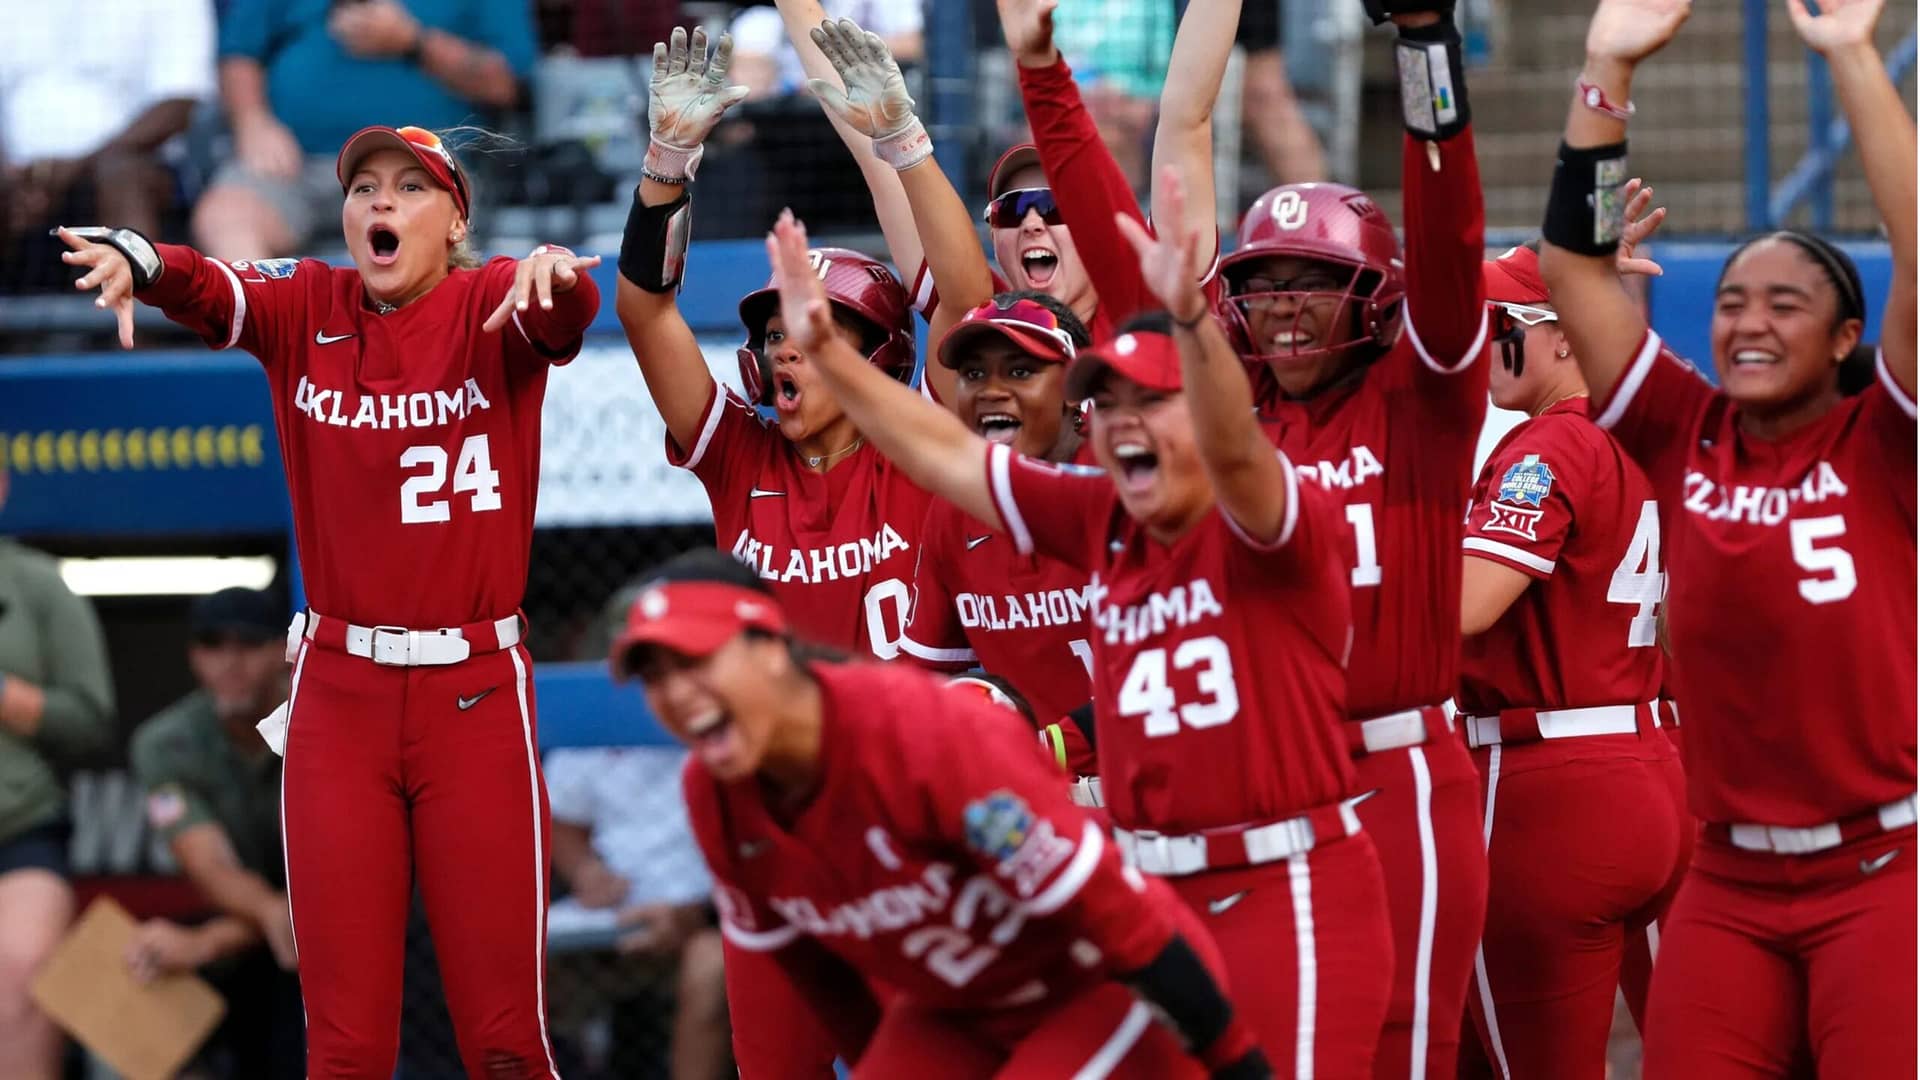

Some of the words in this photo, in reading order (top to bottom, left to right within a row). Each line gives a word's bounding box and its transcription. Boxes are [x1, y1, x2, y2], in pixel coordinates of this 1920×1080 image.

[1270, 190, 1308, 231] OU
[295, 375, 490, 430] OKLAHOMA
[399, 433, 502, 524] 24
[732, 522, 910, 584] OKLAHOMA
[1345, 503, 1382, 588] 1
[1607, 500, 1668, 648] 4
[1789, 514, 1857, 605] 5
[864, 578, 911, 661] 0
[955, 584, 1097, 632] OKLAHOM
[1118, 635, 1240, 738] 43
